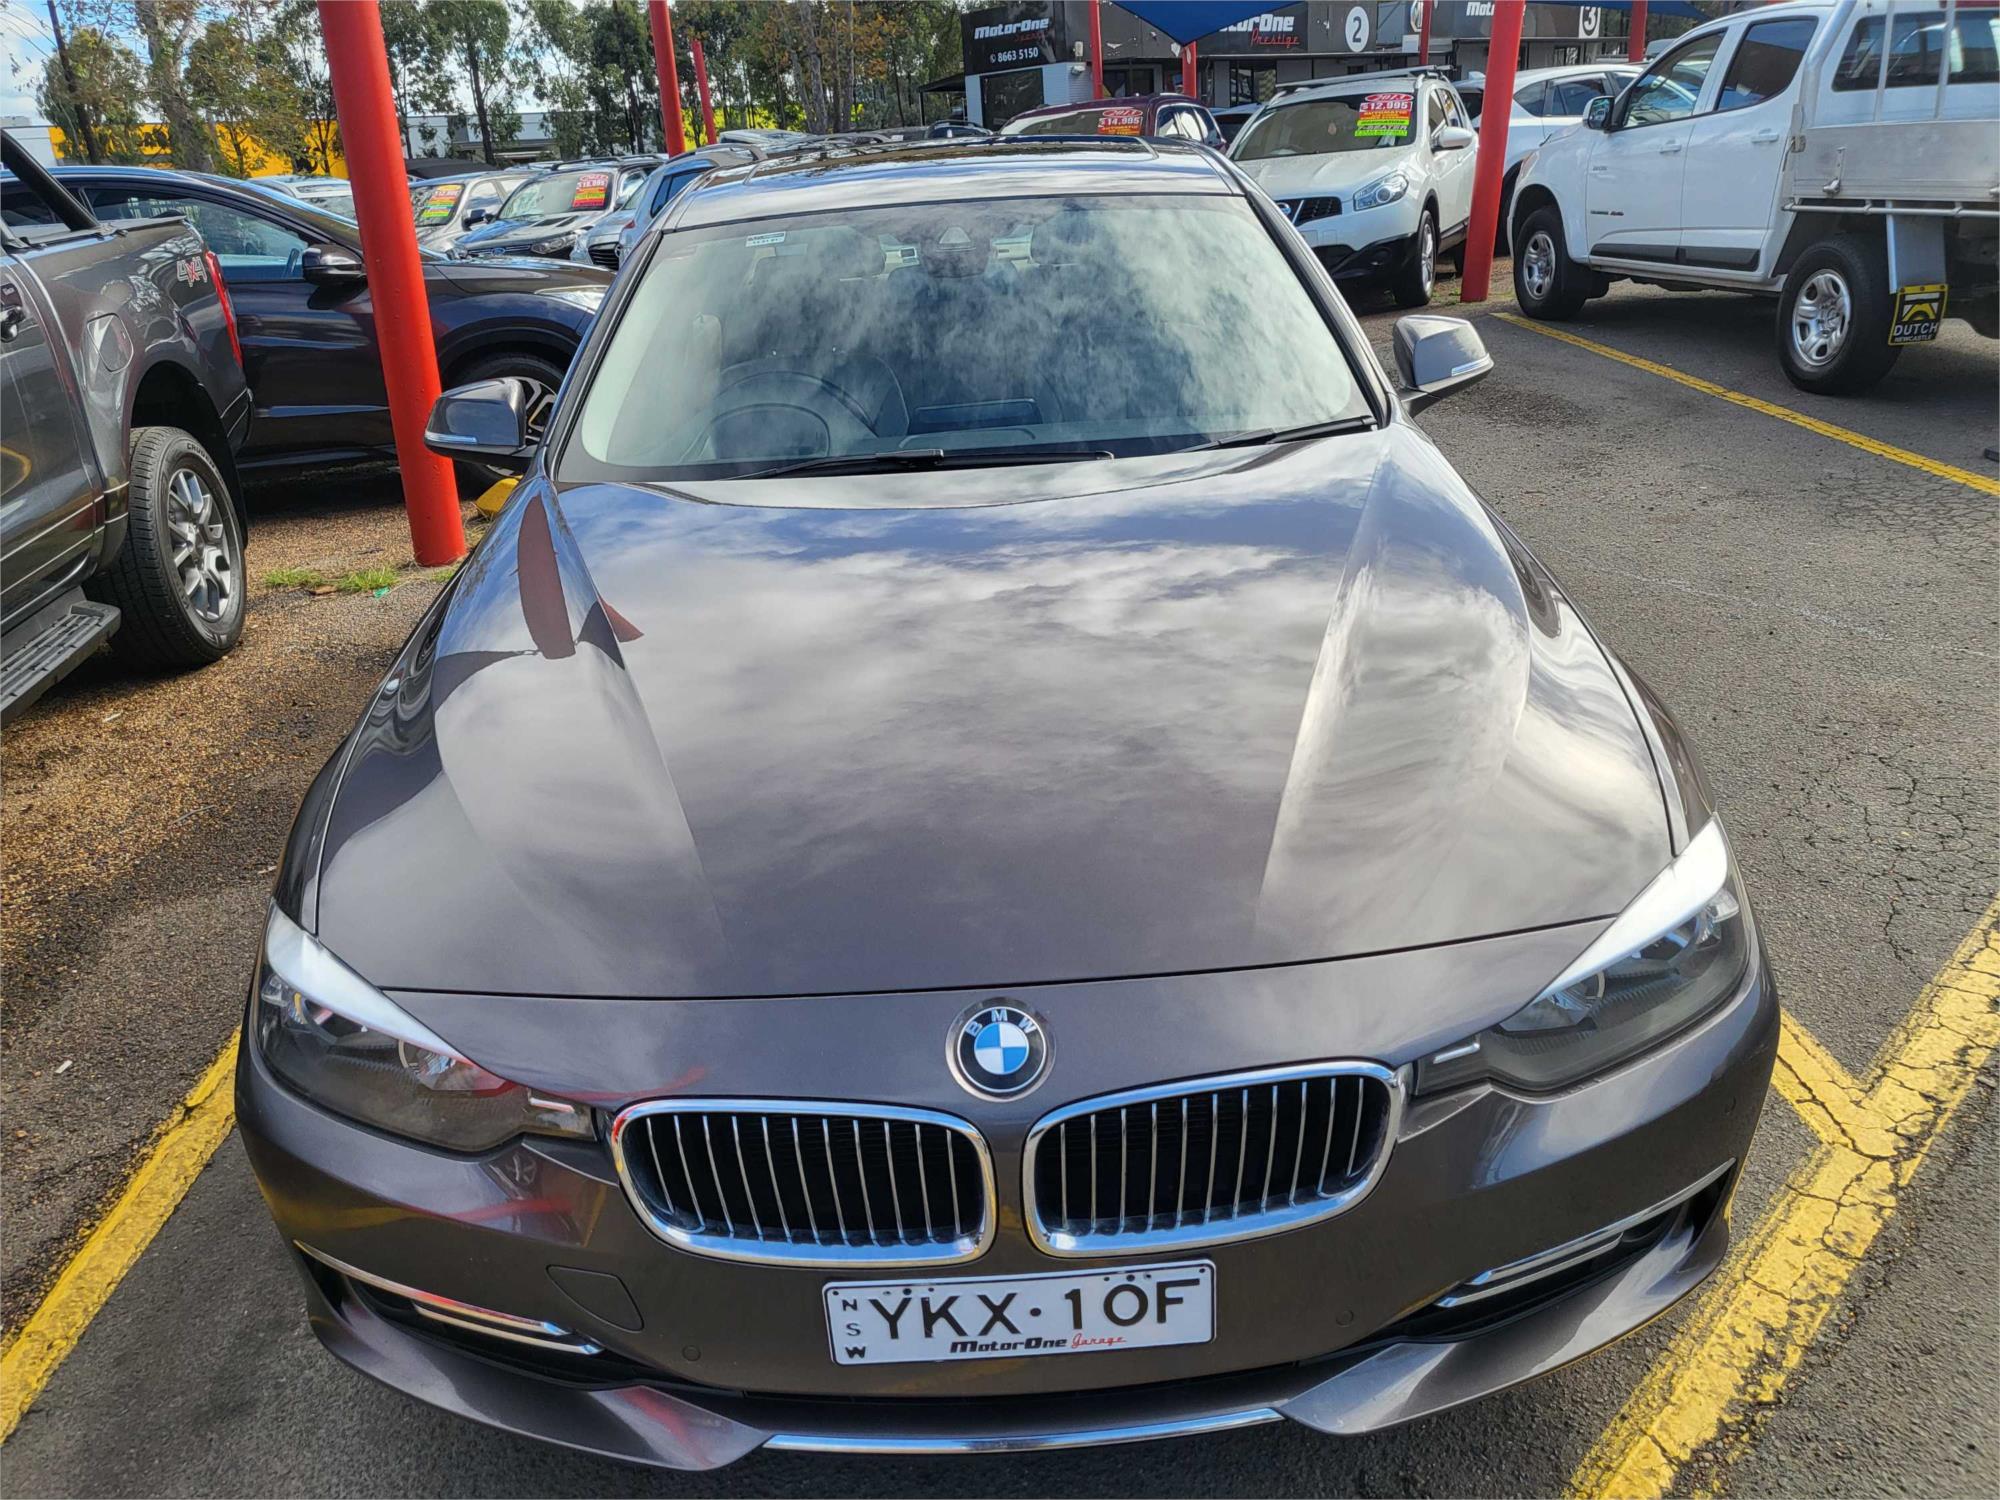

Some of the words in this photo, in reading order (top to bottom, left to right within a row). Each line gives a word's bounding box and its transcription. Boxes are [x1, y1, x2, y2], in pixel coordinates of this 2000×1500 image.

[974, 18, 1050, 39] MotorOne
[1352, 16, 1362, 43] 2
[997, 50, 1017, 62] 8663
[1018, 47, 1039, 60] 5150
[1894, 322, 1938, 336] DUTCH
[965, 1007, 1037, 1038] BMW
[949, 1337, 1068, 1353] MotorOne
[1071, 1333, 1127, 1348] Garage
